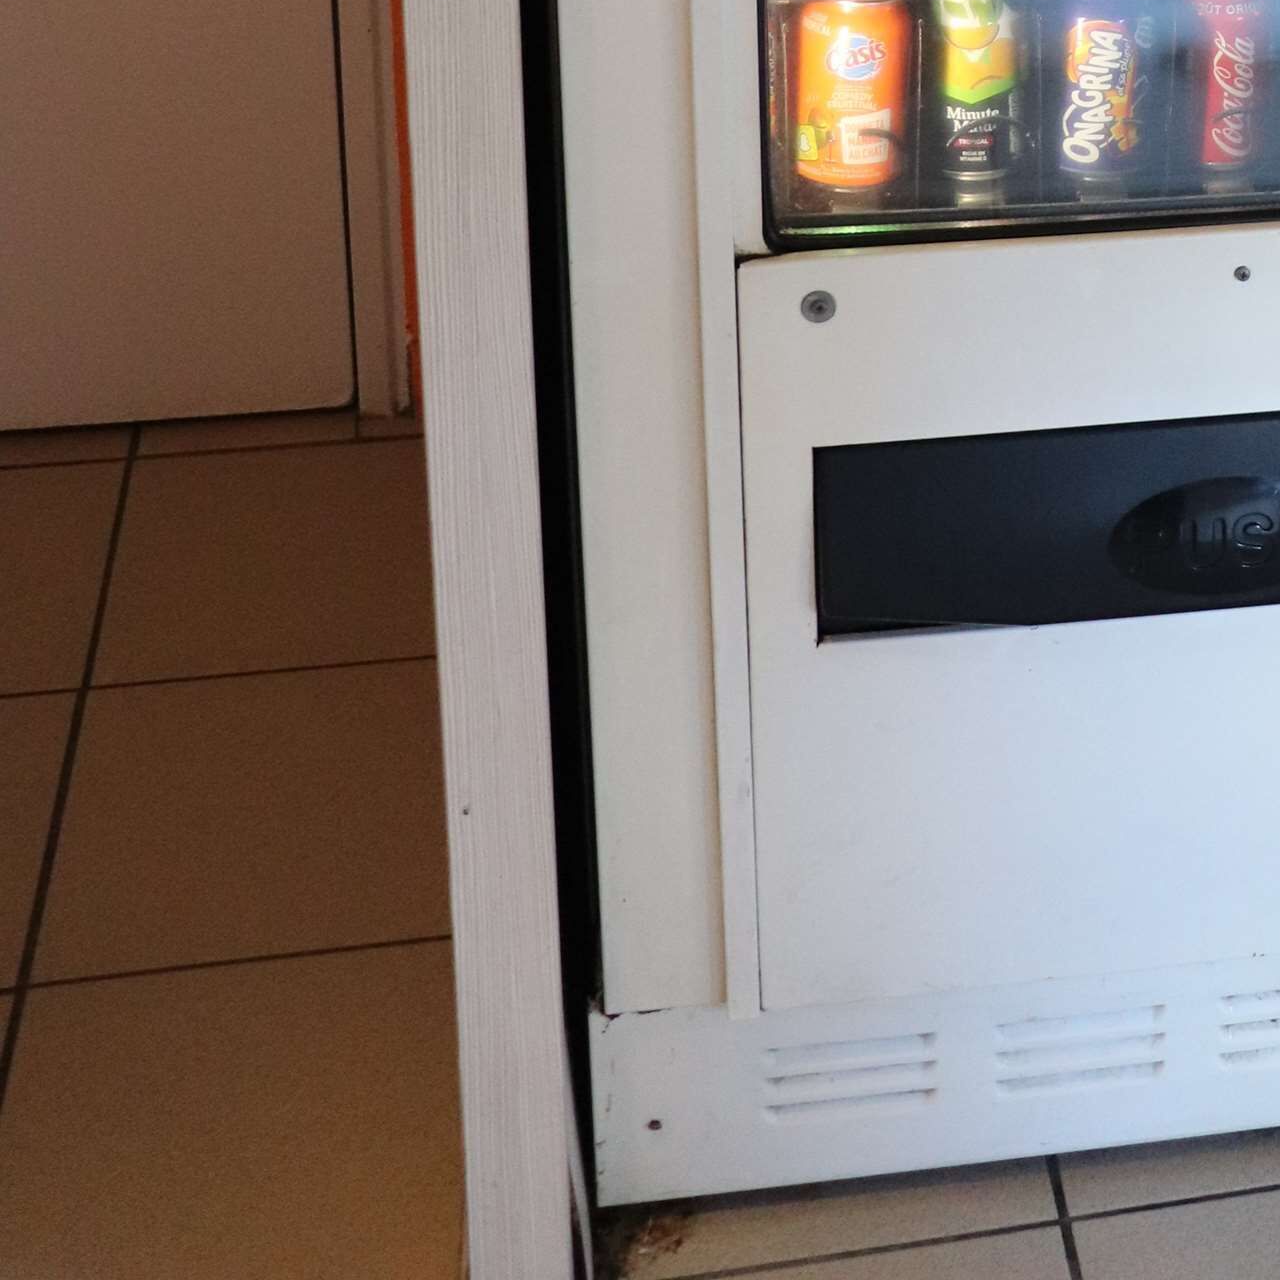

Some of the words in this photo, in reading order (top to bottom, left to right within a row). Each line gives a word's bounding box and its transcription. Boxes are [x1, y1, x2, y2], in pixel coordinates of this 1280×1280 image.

[946, 105, 1000, 120] Minute
[1063, 30, 1123, 164] ONAGRINA
[1212, 30, 1255, 158] Coca-Cola
